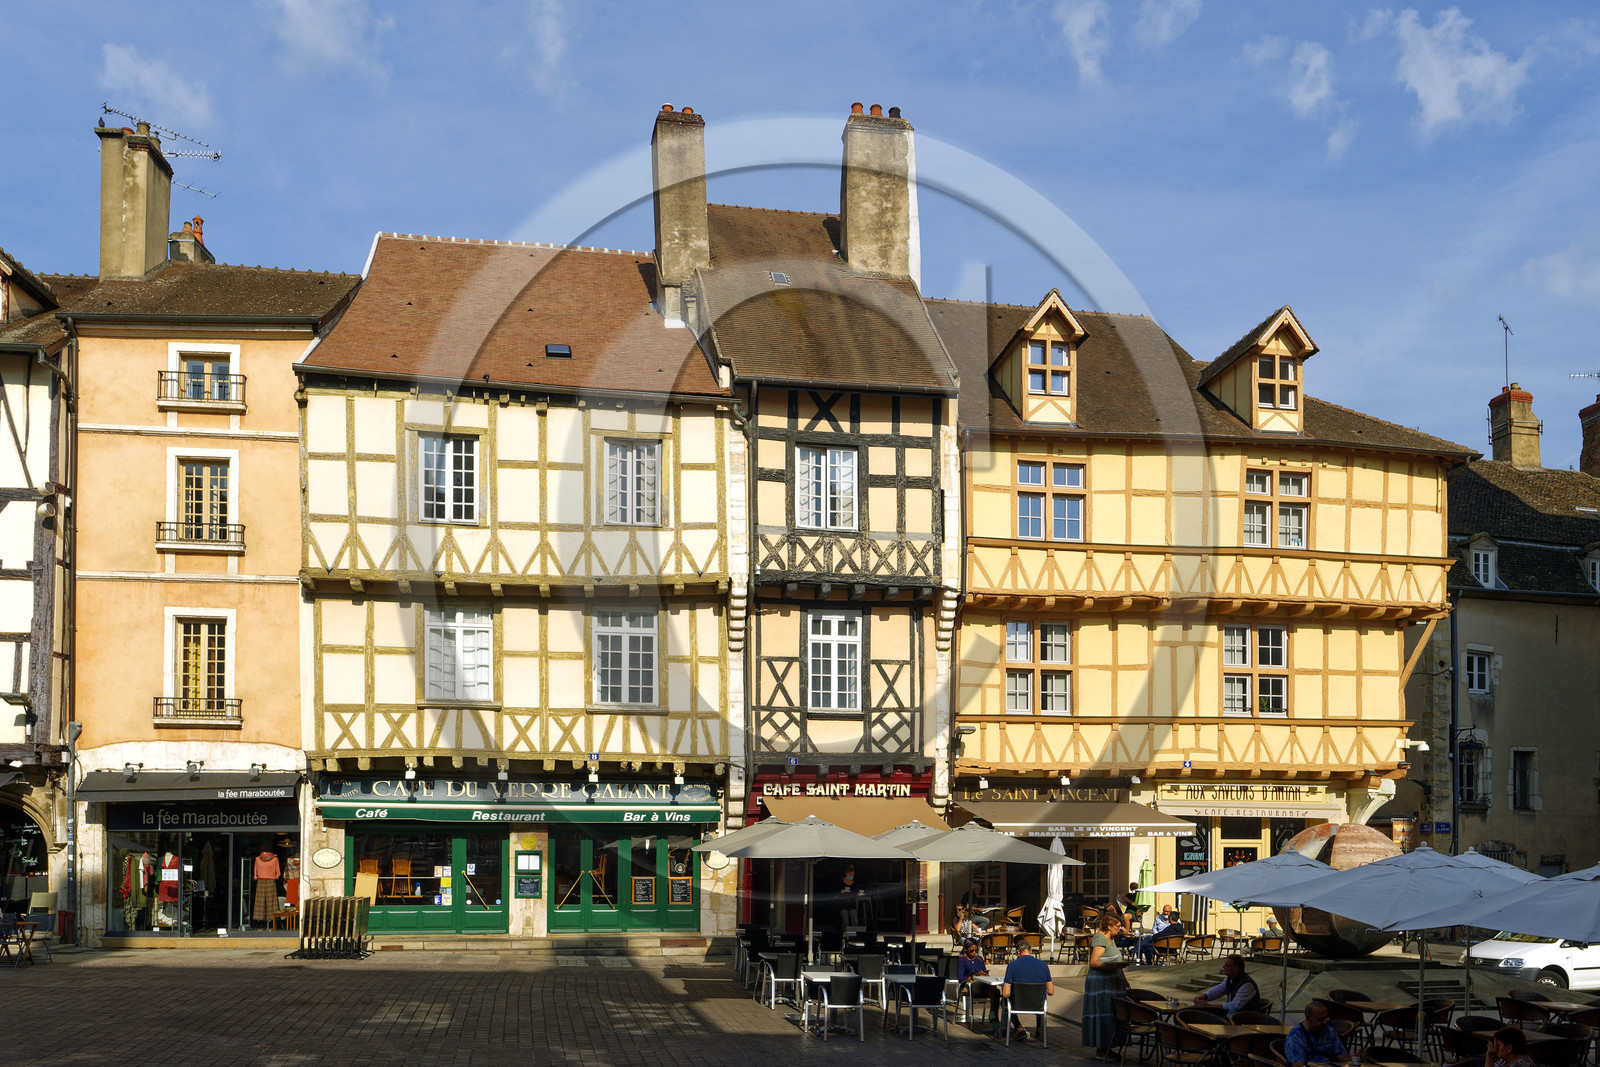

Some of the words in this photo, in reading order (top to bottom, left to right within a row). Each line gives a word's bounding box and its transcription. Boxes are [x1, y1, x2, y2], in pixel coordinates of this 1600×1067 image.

[226, 790, 238, 799] fée
[445, 781, 478, 798] DU
[489, 782, 571, 799] VERRE
[581, 783, 671, 800] GALANT
[763, 784, 801, 796] CAFE
[806, 784, 850, 796] SAINT
[855, 784, 911, 796] MARTIN
[991, 787, 1041, 800] SAINT
[1050, 788, 1120, 801] VINCENT
[1186, 785, 1206, 799] AUX
[1212, 785, 1255, 800] SAVEURS
[1262, 785, 1301, 801] D'ANTAN
[142, 811, 154, 825] la
[157, 809, 179, 831] fée
[355, 808, 388, 818] Café
[472, 810, 545, 821] Restaurant
[623, 812, 646, 822] Bar
[651, 812, 659, 821] à
[665, 812, 691, 821] Vins
